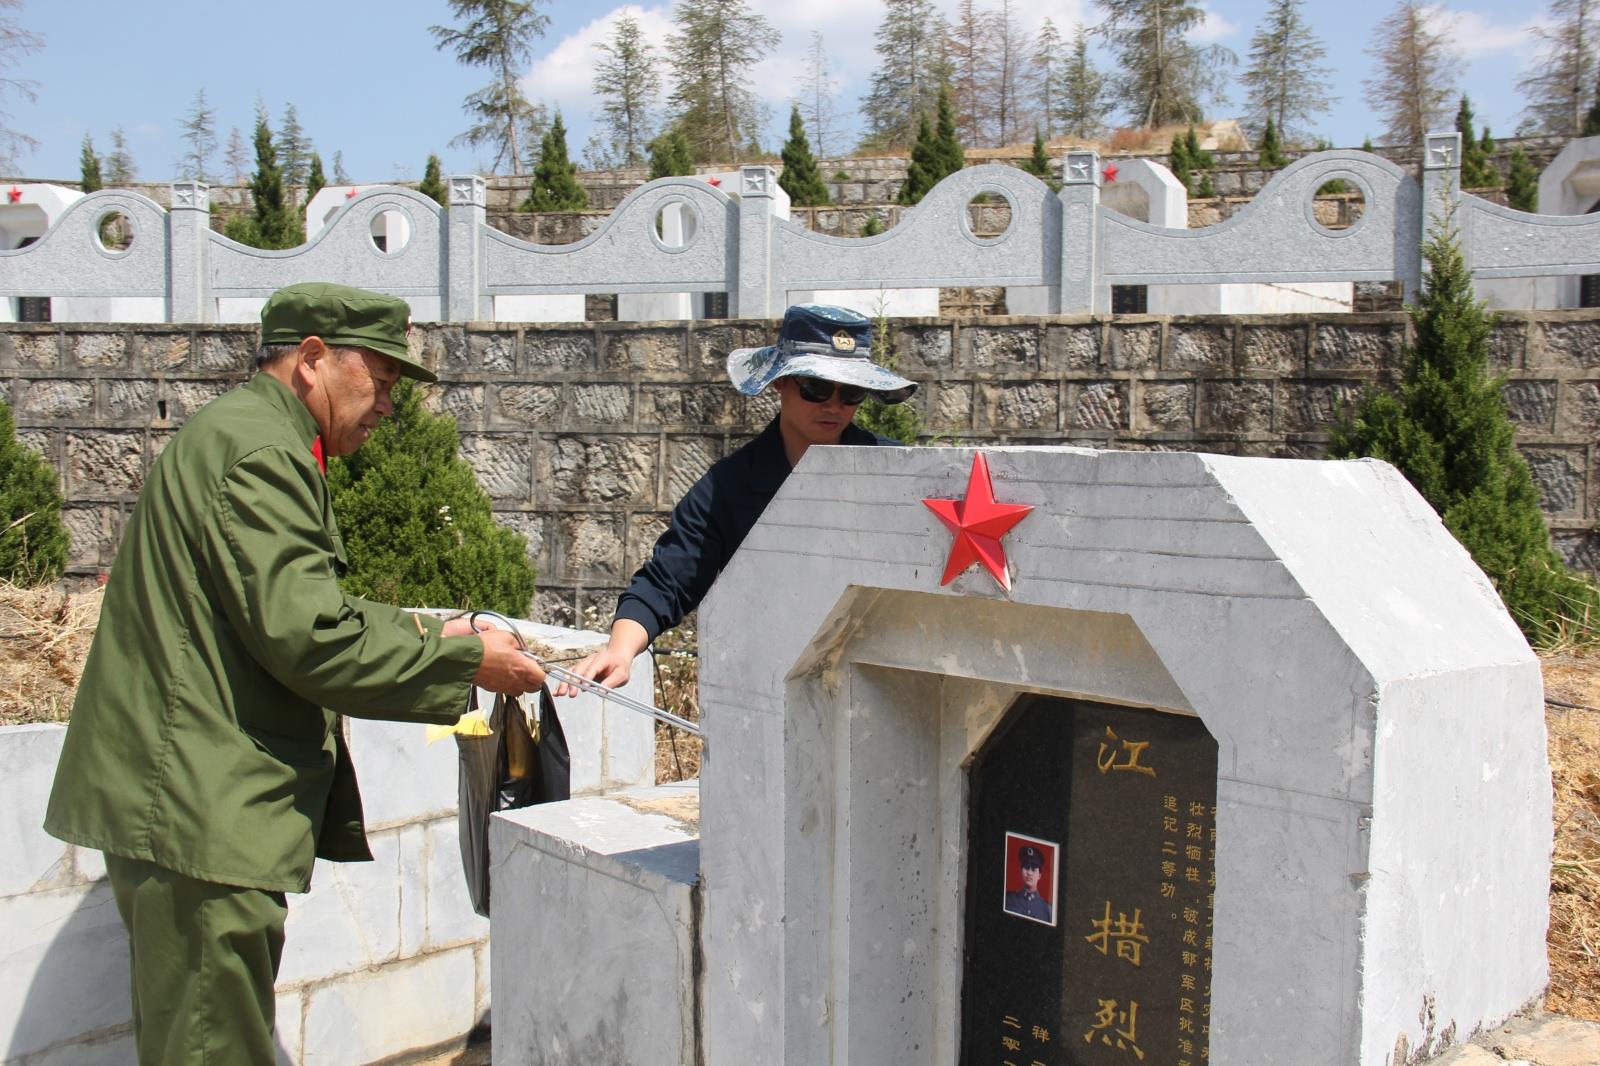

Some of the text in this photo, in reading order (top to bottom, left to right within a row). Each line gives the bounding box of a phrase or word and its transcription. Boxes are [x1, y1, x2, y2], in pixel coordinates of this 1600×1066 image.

[1085, 725, 1157, 1060] 江措烈
[1161, 795, 1179, 919] 追记二等功。
